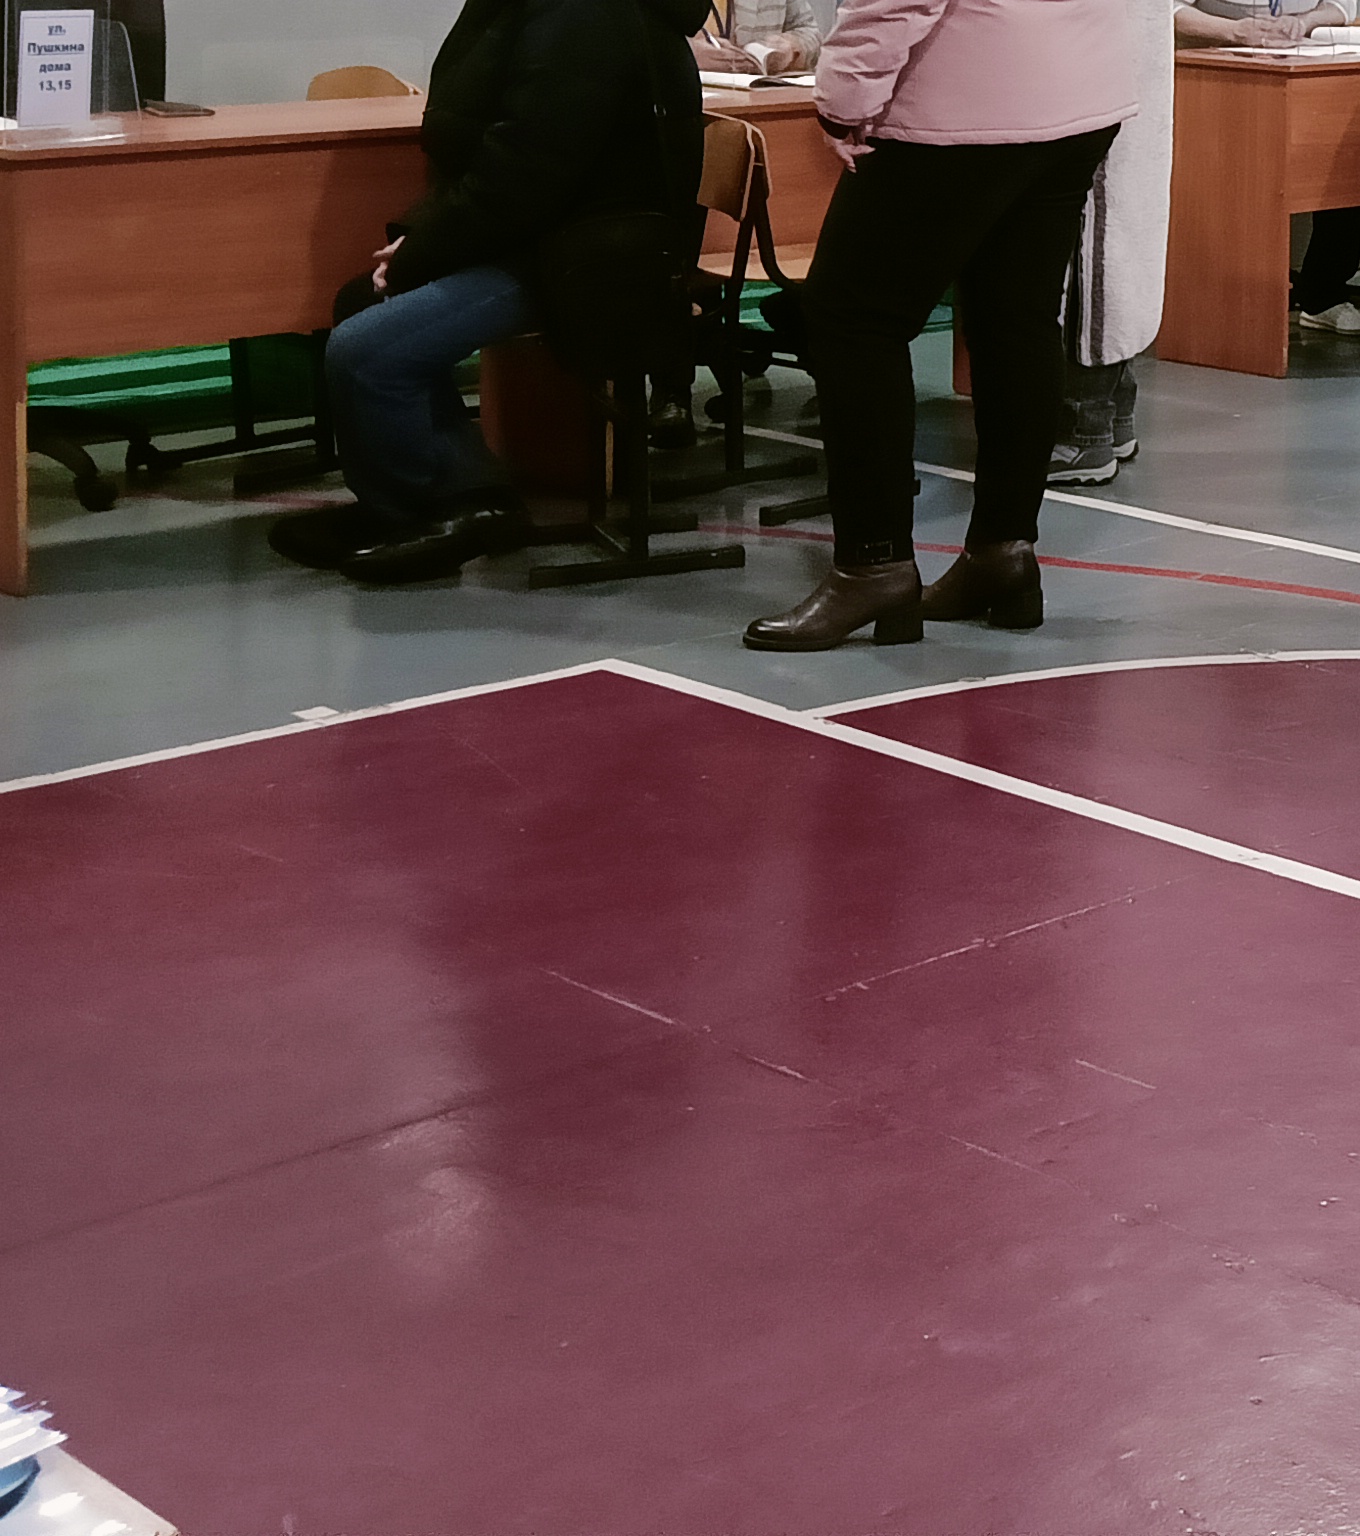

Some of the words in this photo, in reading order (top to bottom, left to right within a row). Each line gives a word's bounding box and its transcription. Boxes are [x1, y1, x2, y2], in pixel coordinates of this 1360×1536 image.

[48, 25, 66, 35] ул.
[27, 42, 84, 55] Пушкина
[39, 63, 71, 73] дома
[39, 79, 72, 92] 13,15
